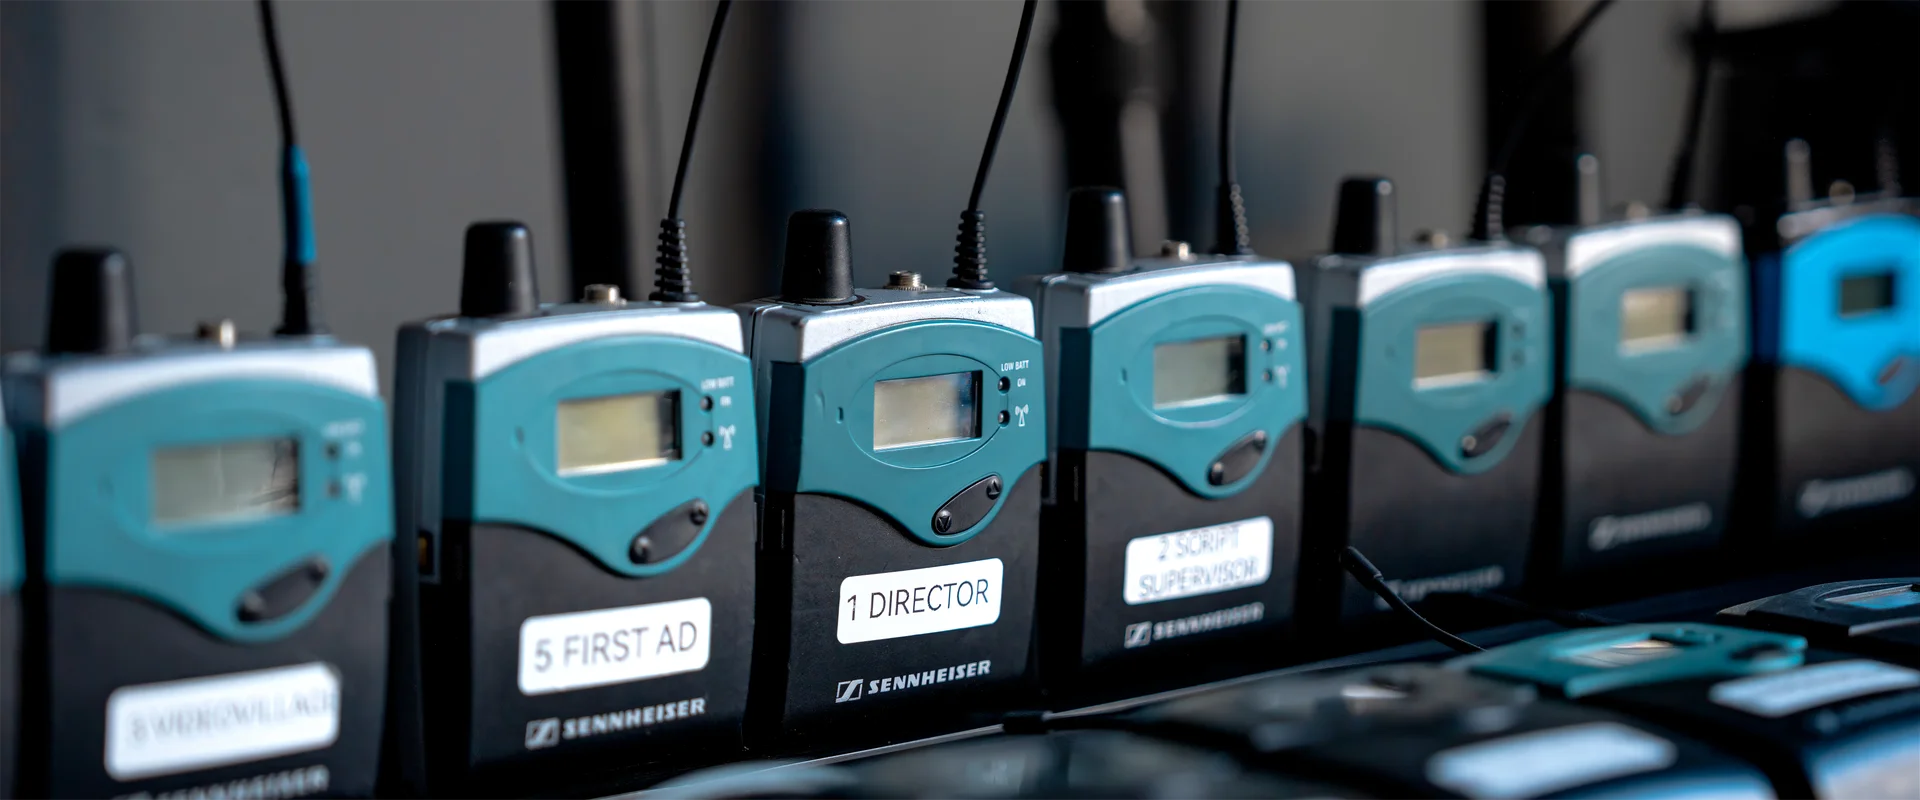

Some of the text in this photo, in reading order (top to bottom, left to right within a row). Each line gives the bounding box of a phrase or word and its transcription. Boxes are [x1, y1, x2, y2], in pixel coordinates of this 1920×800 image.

[1001, 360, 1029, 371] LOW BATT
[1017, 378, 1026, 387] ON
[1158, 523, 1243, 561] 2 SCRIPT
[847, 578, 989, 621] 1 DIRECTOR
[534, 620, 698, 673] 5 FIRST AD
[868, 659, 991, 694] SENNHEISER
[562, 697, 706, 740] SENNHEISER
